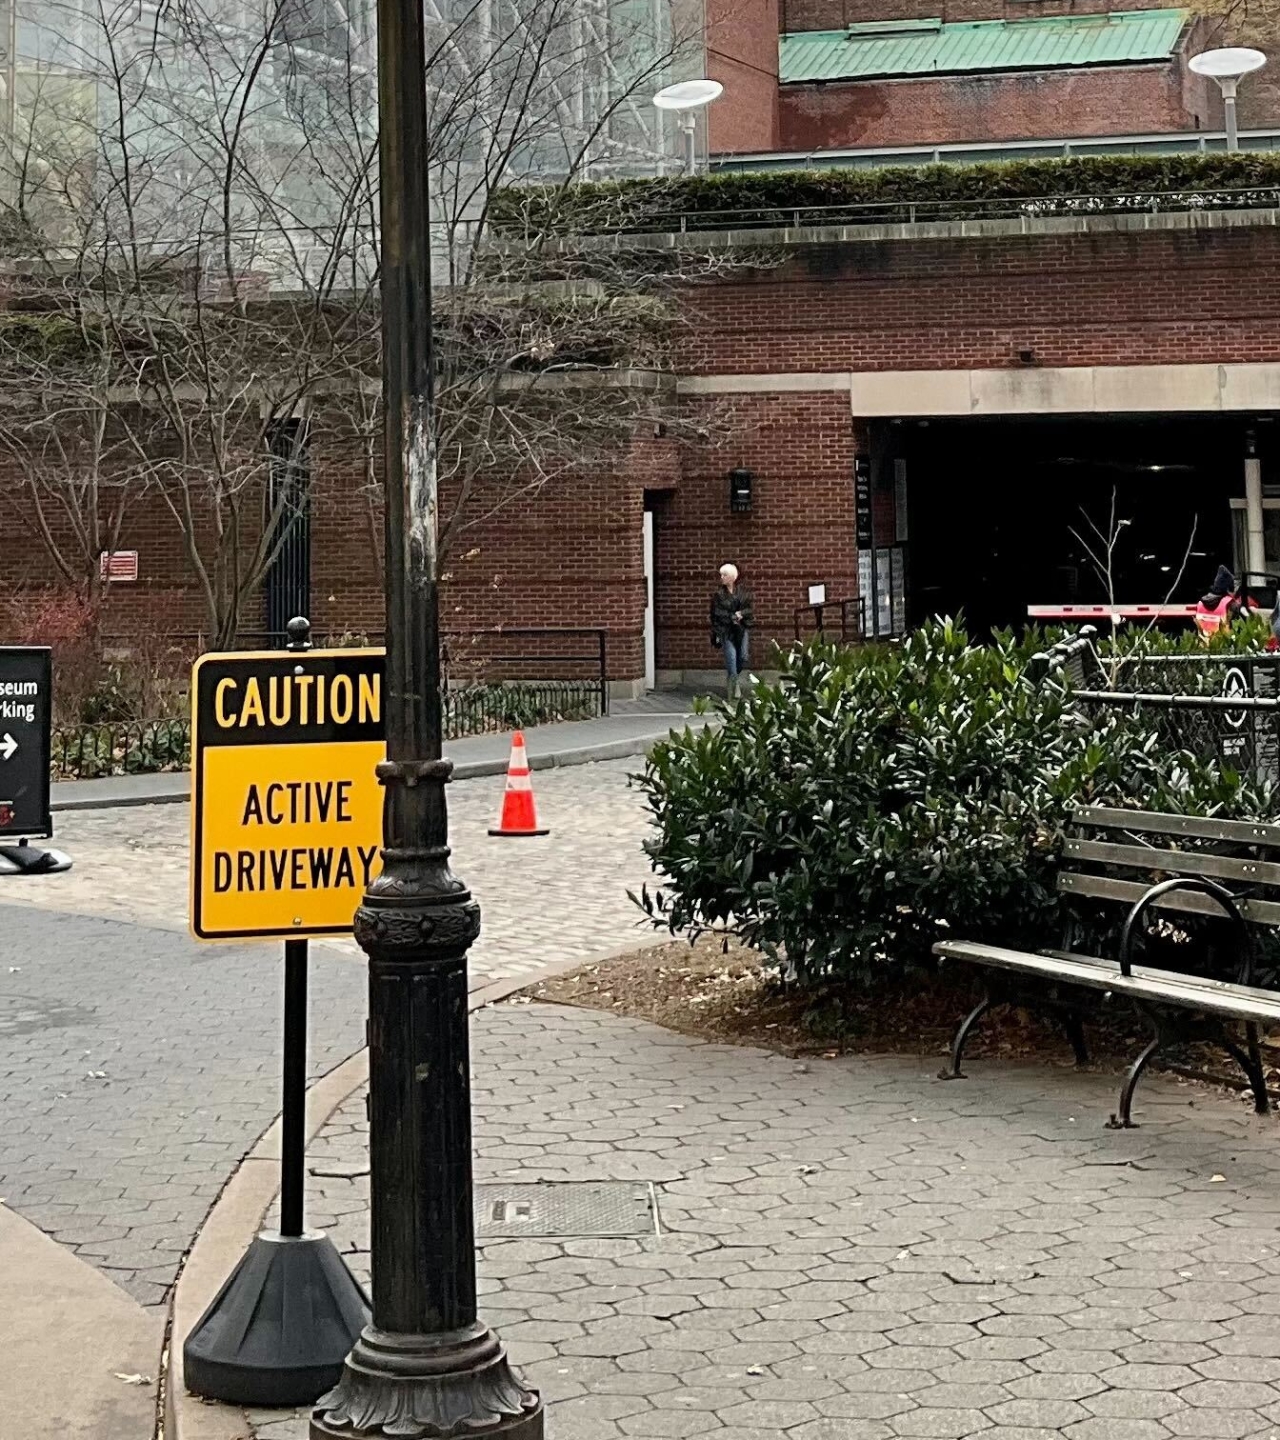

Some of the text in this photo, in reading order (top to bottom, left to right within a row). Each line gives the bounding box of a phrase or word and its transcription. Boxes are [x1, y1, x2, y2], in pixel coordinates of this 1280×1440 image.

[214, 672, 381, 729] CAUTION
[241, 780, 353, 826] ACTIVE
[213, 845, 378, 893] DRIVEWAY
